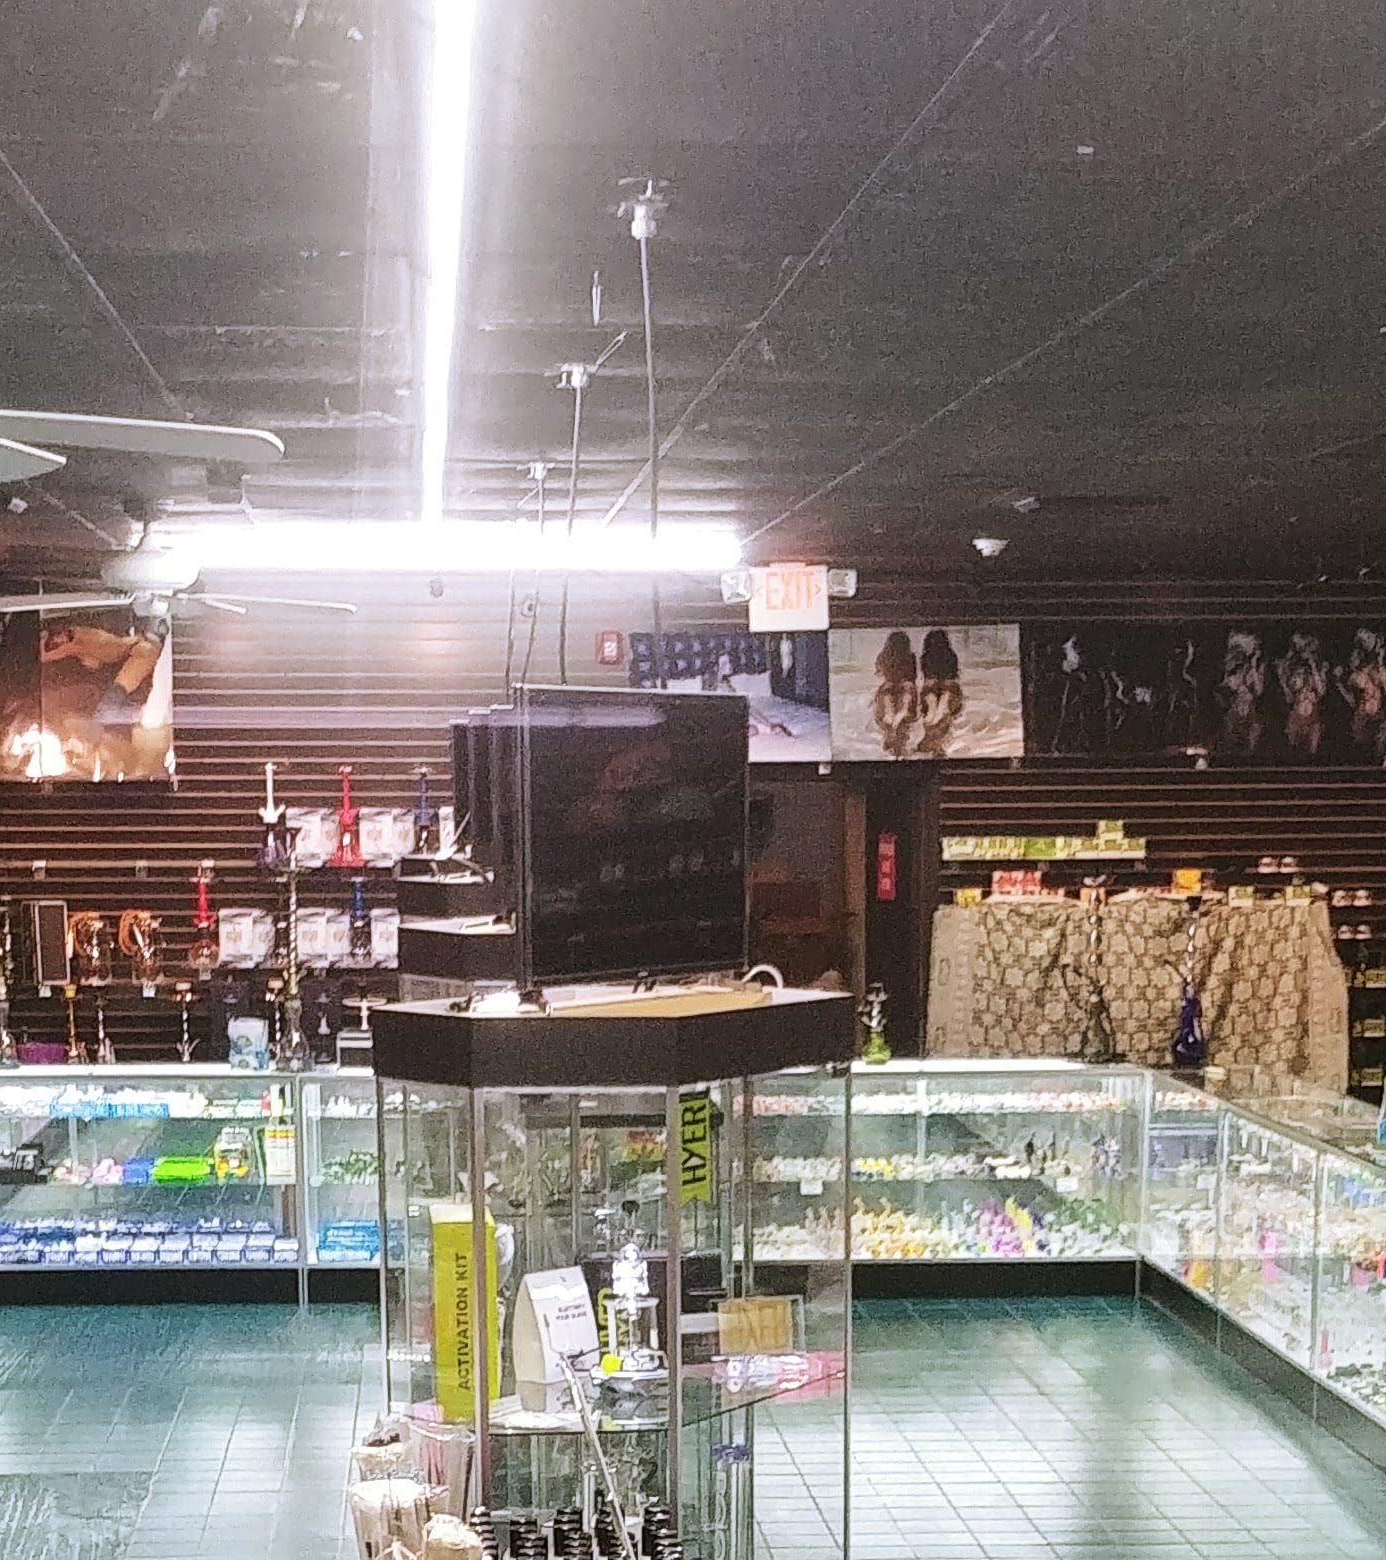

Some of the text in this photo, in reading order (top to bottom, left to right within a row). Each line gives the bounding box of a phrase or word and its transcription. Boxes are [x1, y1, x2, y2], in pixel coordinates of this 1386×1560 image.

[766, 571, 814, 610] EXIT
[455, 1252, 471, 1391] ACTIVATION KIT
